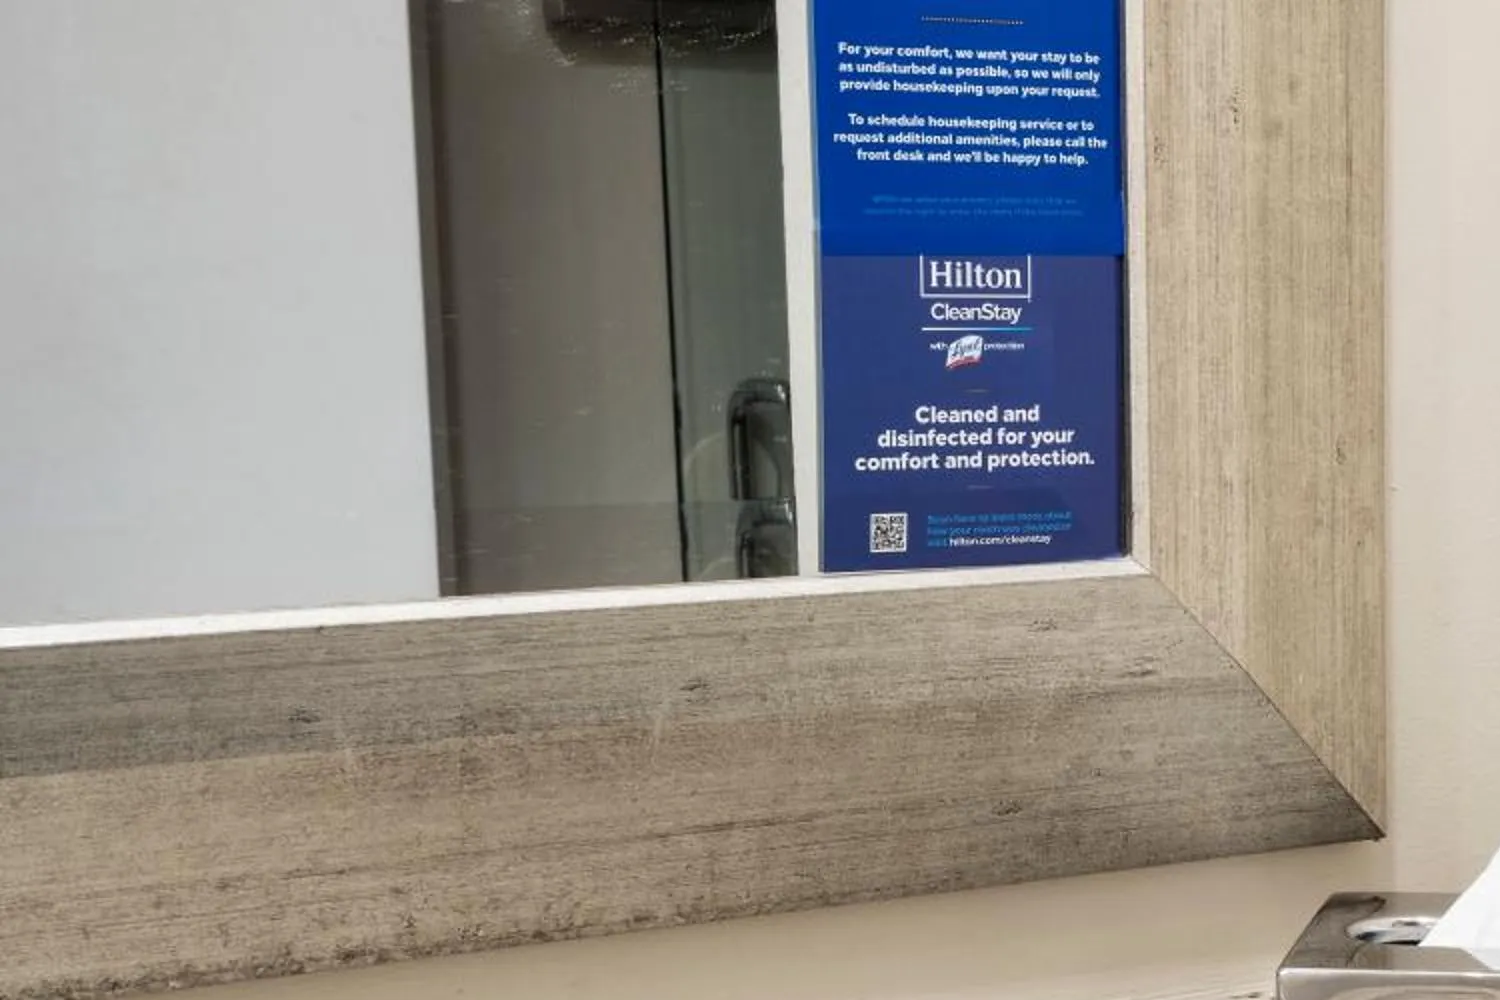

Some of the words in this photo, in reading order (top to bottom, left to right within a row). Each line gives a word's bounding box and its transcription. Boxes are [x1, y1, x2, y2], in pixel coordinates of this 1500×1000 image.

[838, 41, 860, 55] For
[864, 46, 894, 58] your
[897, 45, 952, 60] comfort,
[955, 48, 973, 59] we
[976, 49, 1007, 60] want
[1010, 51, 1038, 64] your
[1041, 51, 1066, 65] stay
[1070, 52, 1082, 63] to
[1085, 52, 1100, 64] be
[839, 62, 853, 73] as
[856, 61, 936, 75] undisturbed
[940, 65, 953, 75] as
[956, 65, 1011, 79] possible,
[1014, 68, 1028, 78] so
[1031, 69, 1048, 79] we
[1052, 67, 1072, 79] will
[1075, 69, 1100, 84] only
[840, 80, 891, 93] provide
[893, 80, 982, 97] housekeeping
[985, 86, 1018, 97] upon
[1021, 86, 1049, 99] your
[1051, 87, 1100, 100] request.
[848, 113, 864, 125] To
[867, 114, 925, 127] schedule
[928, 115, 1017, 132] housekeeping
[1019, 118, 1062, 130] service
[1066, 121, 1078, 130] or
[1081, 120, 1095, 131] to
[833, 132, 884, 144] request
[887, 132, 953, 145] additional
[955, 134, 1021, 147] amenities,
[1023, 136, 1062, 149] please
[1065, 136, 1085, 147] call
[1088, 137, 1107, 149] the
[857, 147, 890, 160] front
[893, 149, 925, 161] desk
[927, 150, 951, 162] and
[984, 151, 1000, 162] be
[1003, 152, 1040, 166] happy
[1043, 153, 1057, 163] to
[1059, 152, 1088, 167] help.
[930, 261, 1022, 289] Hilton
[930, 303, 1022, 324] CleanStay
[915, 405, 998, 423] Cleaned
[1003, 404, 1040, 422] and
[878, 428, 992, 447] disinfected
[997, 427, 1026, 445] for
[1030, 430, 1075, 448] your
[855, 452, 940, 470] comfort
[944, 451, 982, 468] and
[988, 449, 1095, 472] protection.
